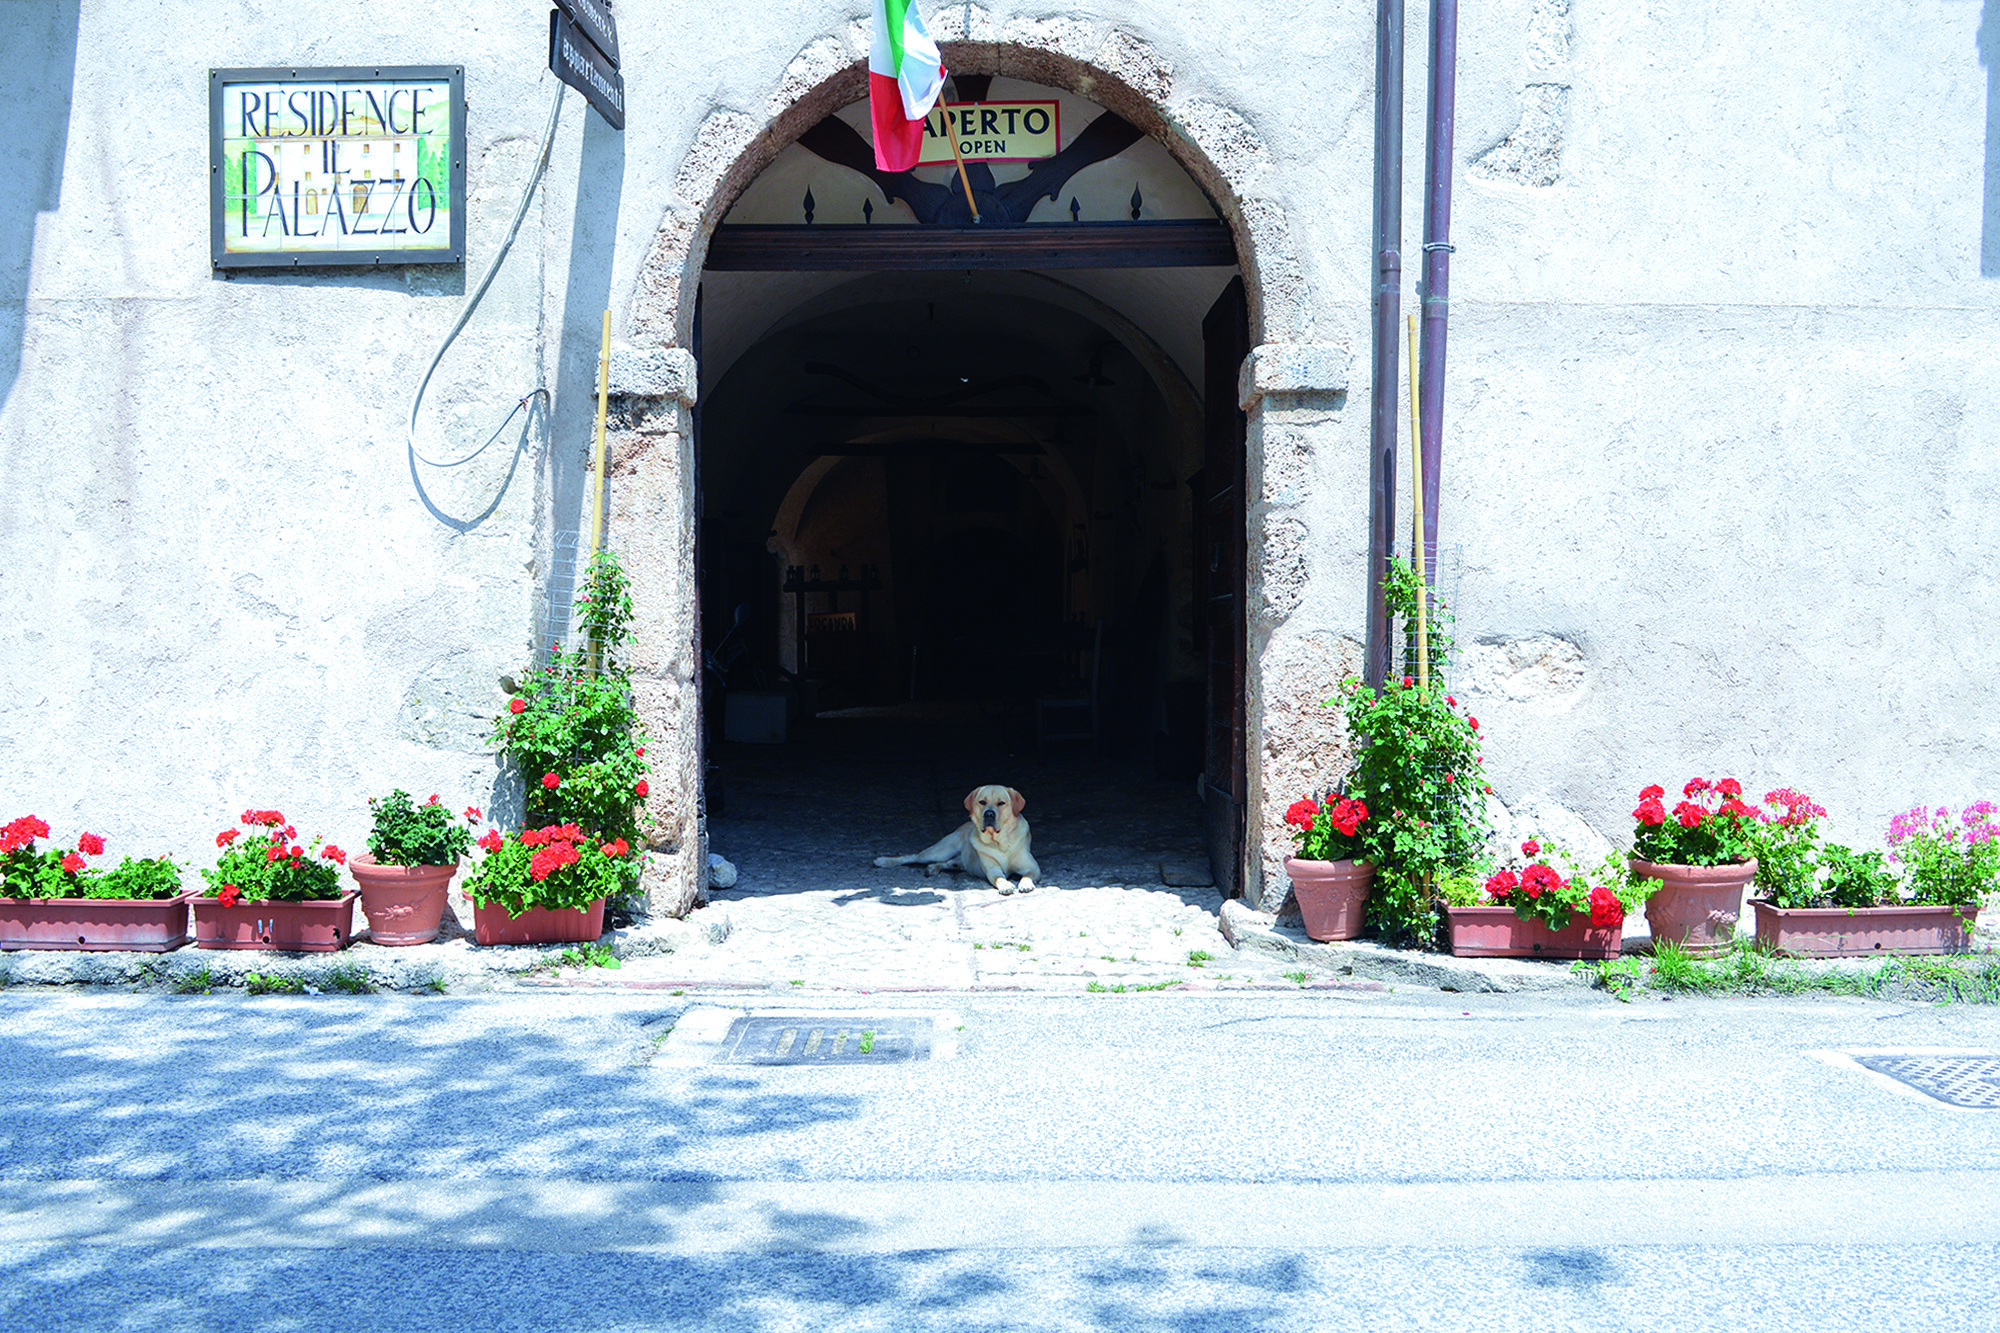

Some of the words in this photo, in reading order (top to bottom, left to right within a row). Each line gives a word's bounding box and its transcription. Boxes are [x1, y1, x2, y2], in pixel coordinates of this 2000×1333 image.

[240, 88, 434, 138] RESIDENCE
[322, 140, 351, 174] IL
[960, 139, 1007, 155] OPEN
[241, 151, 437, 238] PALAZZO
